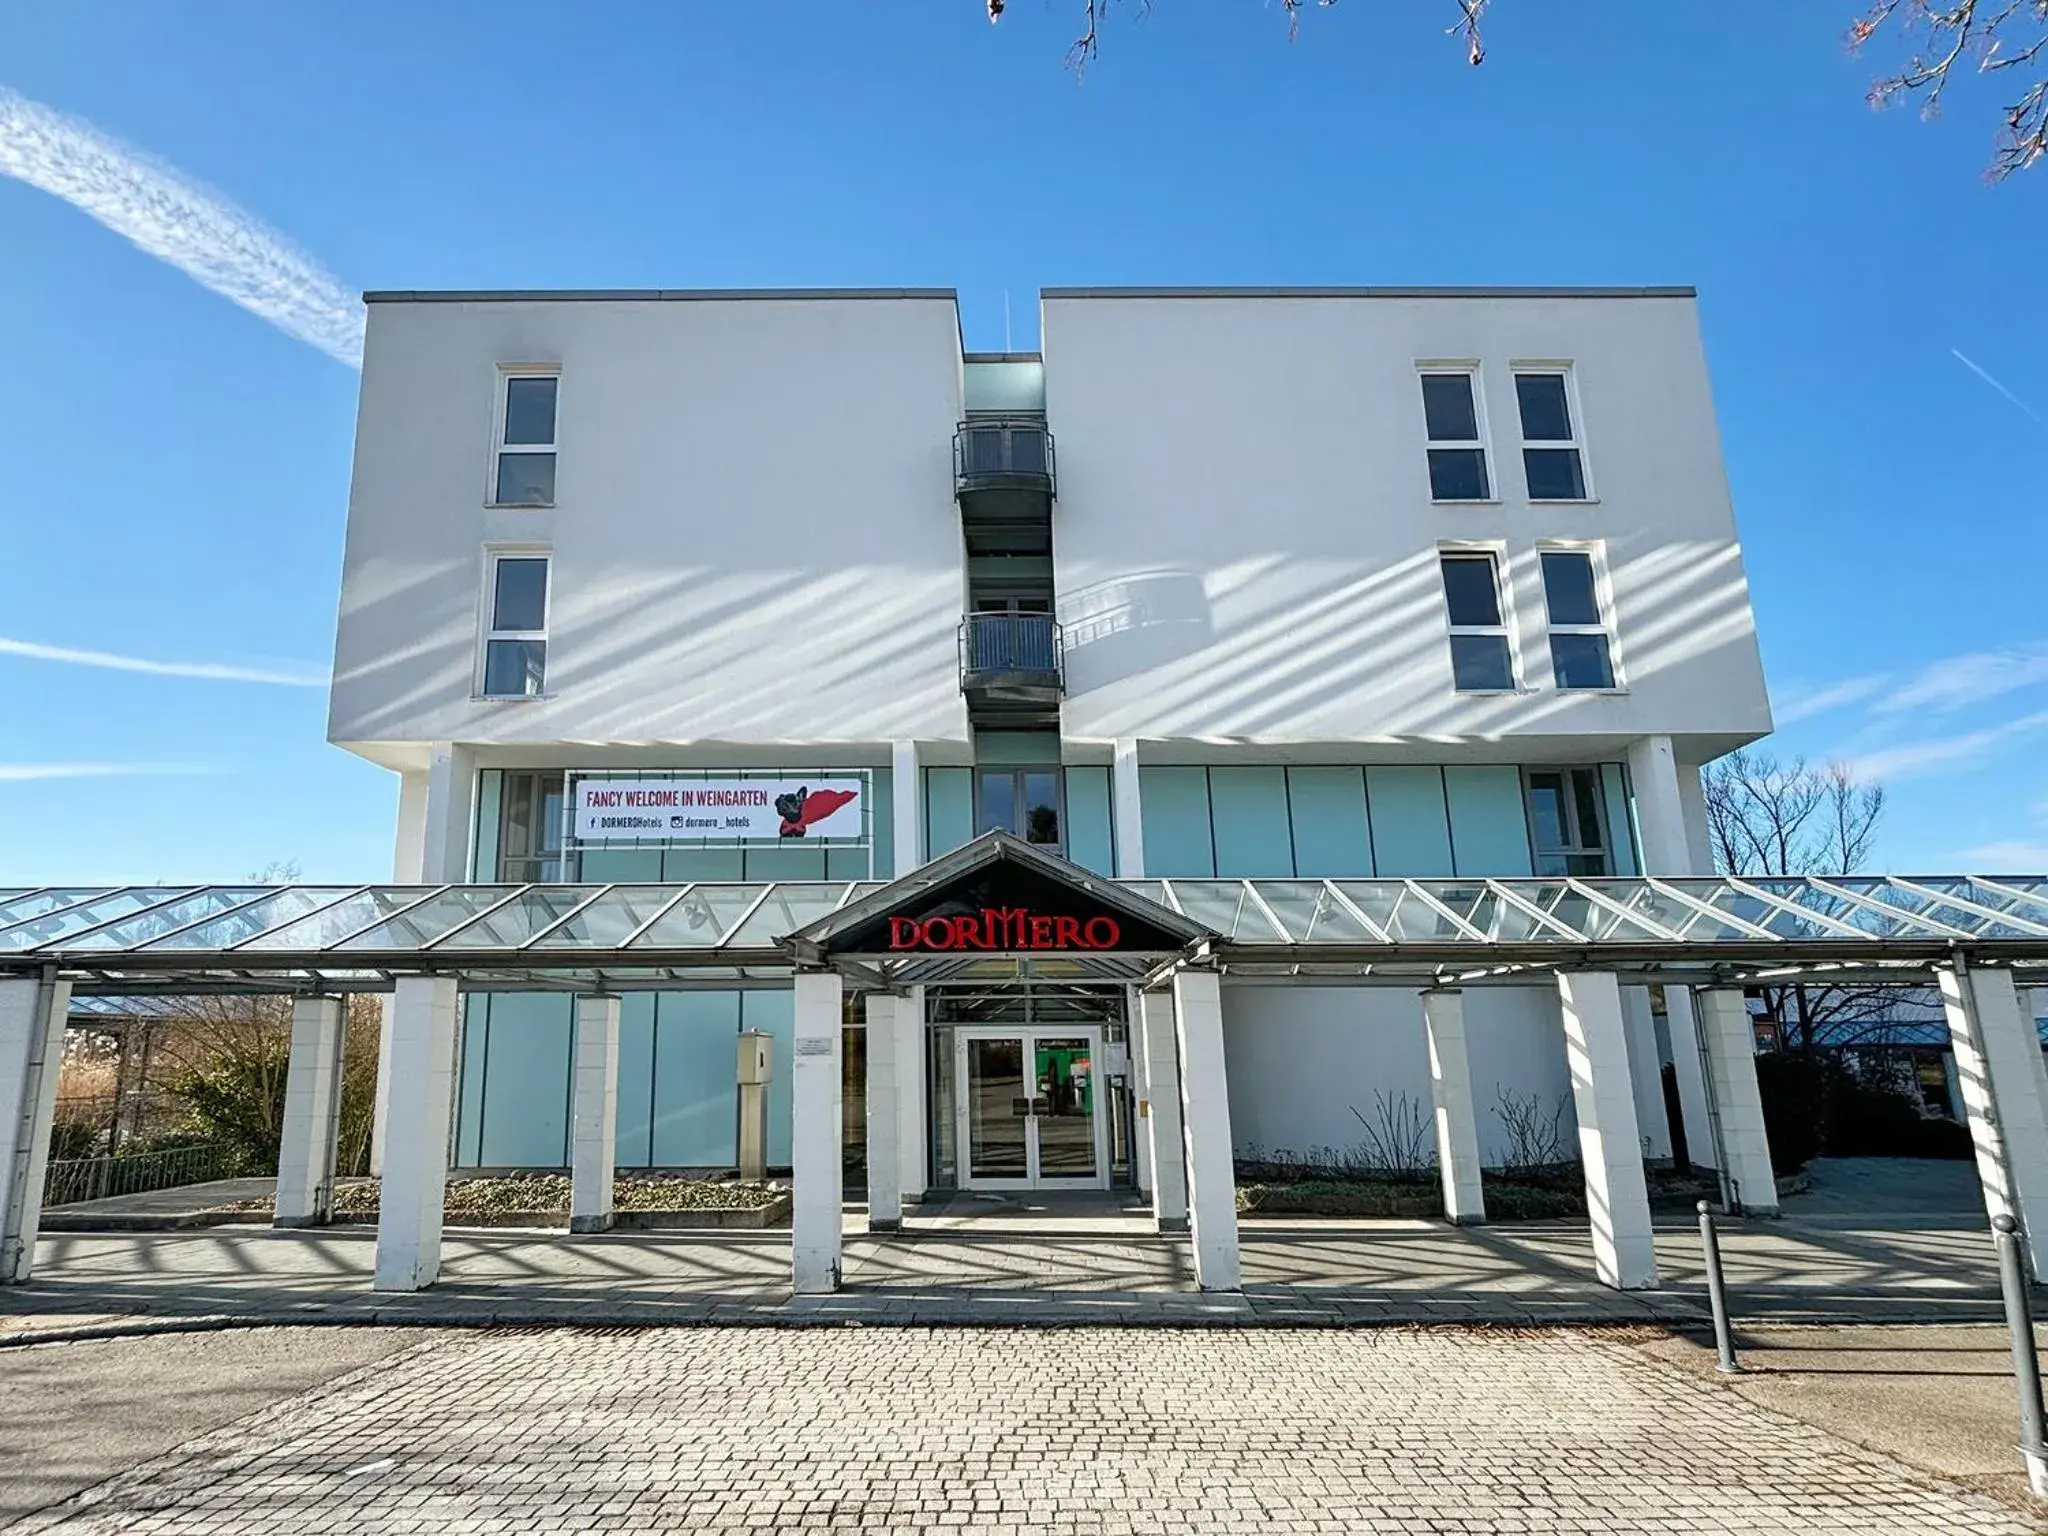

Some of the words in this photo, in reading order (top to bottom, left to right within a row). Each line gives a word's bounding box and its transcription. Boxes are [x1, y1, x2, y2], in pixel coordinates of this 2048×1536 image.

[586, 791, 623, 808] FANCY
[625, 790, 679, 807] WELCOME
[682, 790, 693, 807] IN
[696, 789, 768, 807] WEINGARTEN
[888, 906, 1120, 949] DORMERO
